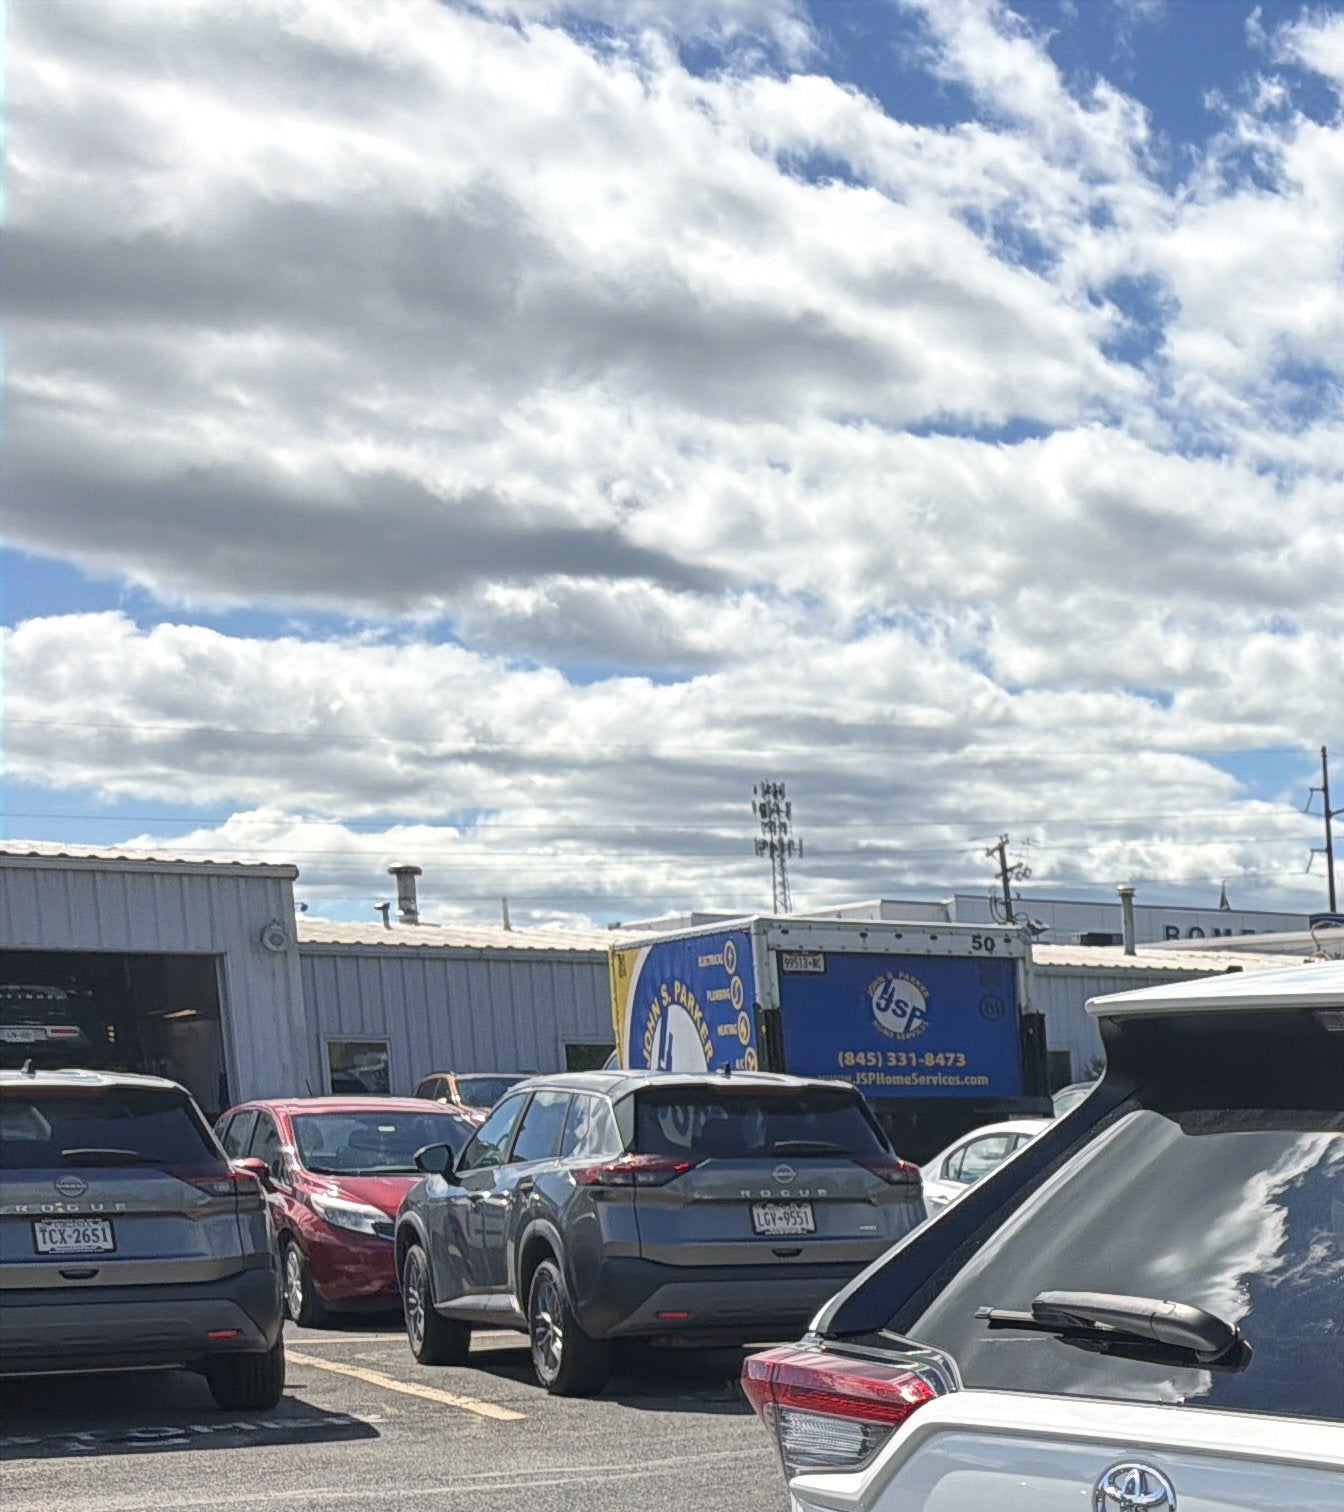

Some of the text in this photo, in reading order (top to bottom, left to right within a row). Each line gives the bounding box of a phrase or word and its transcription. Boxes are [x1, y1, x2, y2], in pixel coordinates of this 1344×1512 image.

[643, 997, 661, 1068] JOHN
[674, 979, 714, 1063] PARKER
[838, 1051, 966, 1068] (845) 331-8473
[740, 1189, 828, 1198] ROGUE
[15, 1202, 126, 1212] ROGUE
[40, 1227, 109, 1246] TCX-2651
